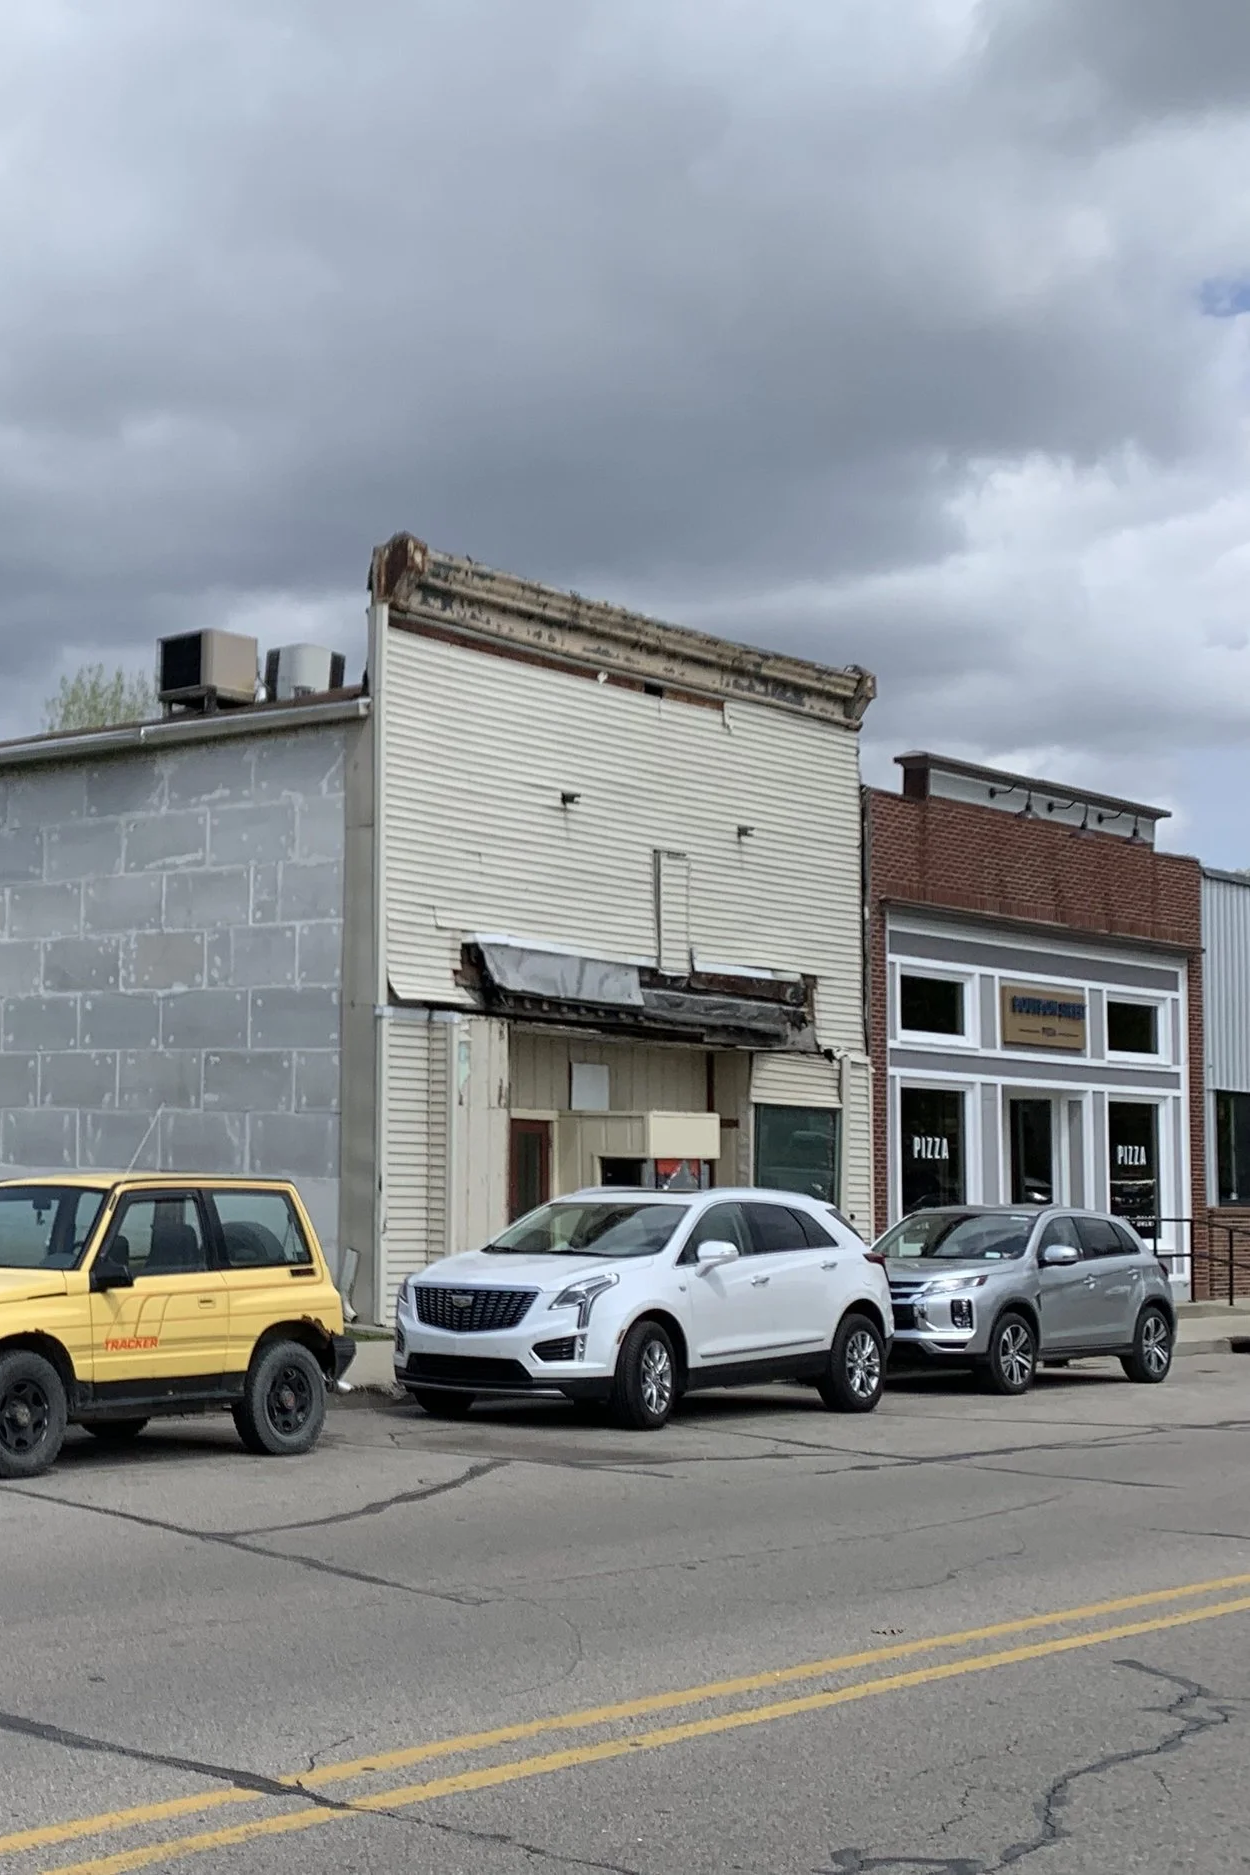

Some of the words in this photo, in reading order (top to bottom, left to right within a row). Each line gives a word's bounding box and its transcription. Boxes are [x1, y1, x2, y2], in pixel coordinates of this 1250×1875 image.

[913, 1136, 949, 1159] PIZZA
[1117, 1145, 1147, 1165] PIZZA
[104, 1336, 158, 1352] TRACKER
